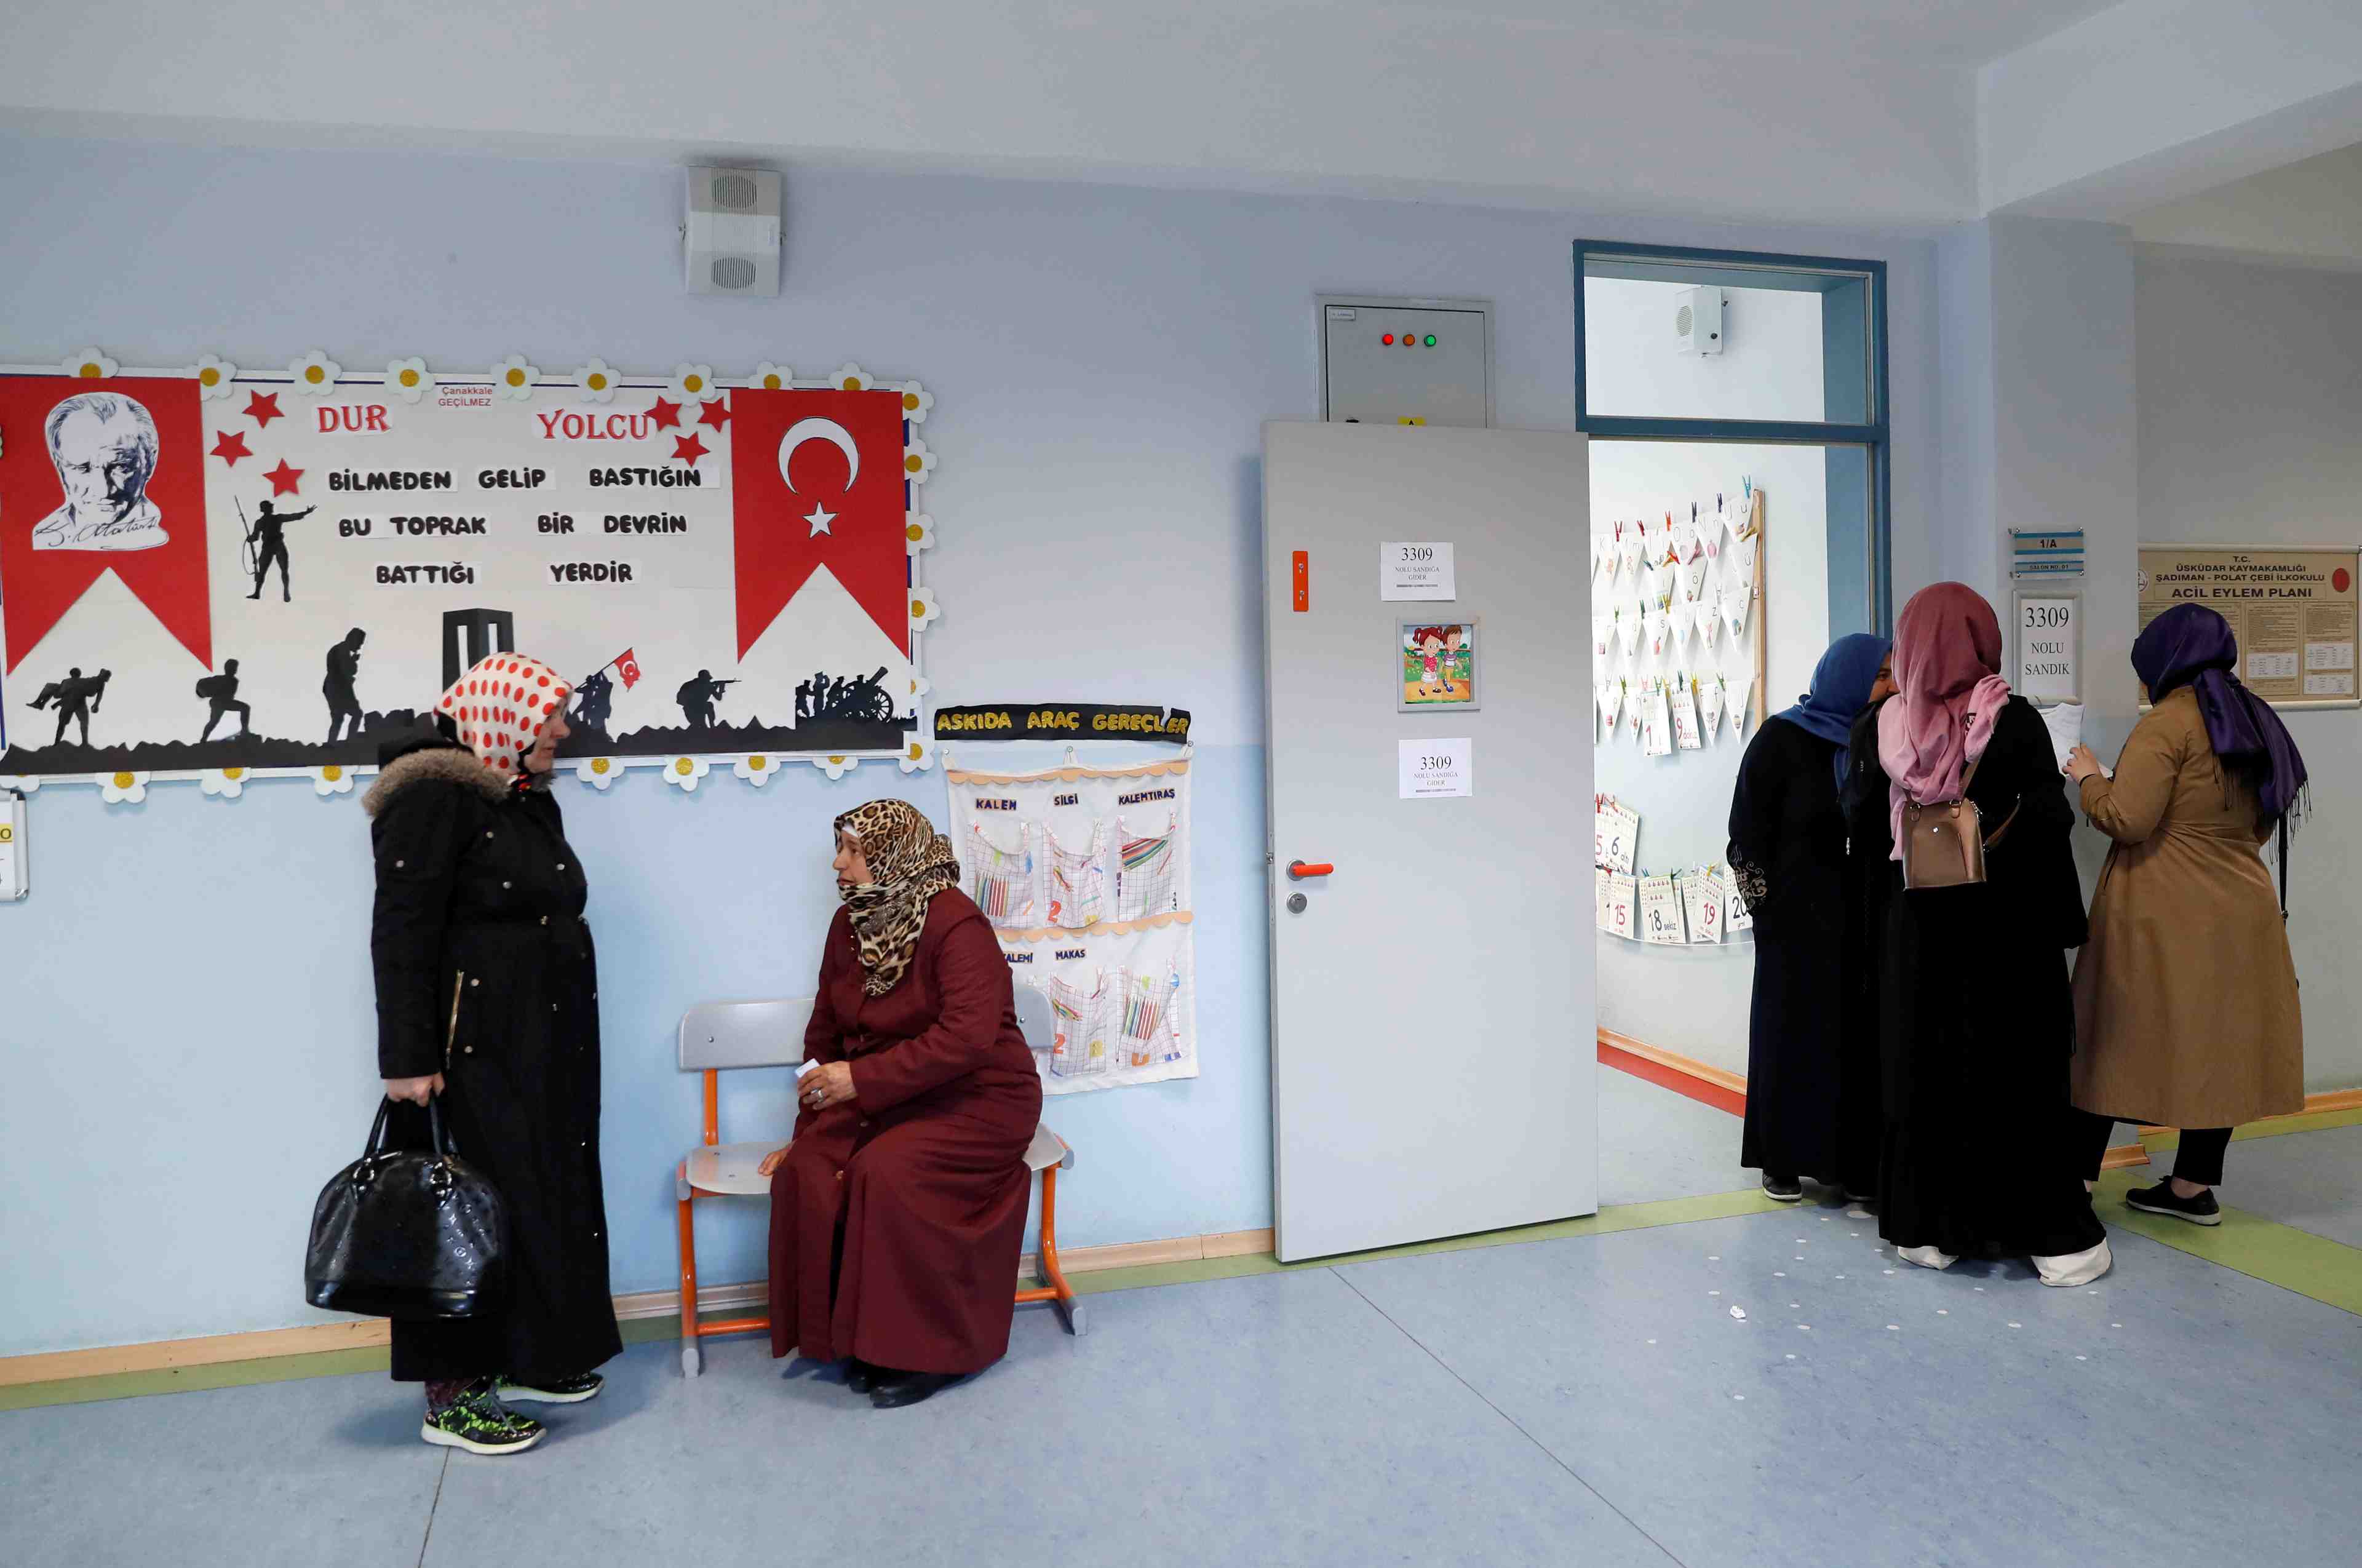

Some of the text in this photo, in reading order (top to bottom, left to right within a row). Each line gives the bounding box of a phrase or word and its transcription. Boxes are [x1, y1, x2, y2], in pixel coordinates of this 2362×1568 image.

[442, 386, 493, 397] Çanakkale
[438, 397, 491, 407] GEÇİLMEZ
[317, 404, 650, 440] DUR YOLCU
[328, 466, 701, 491] BİLMEDEN GELİP BASTIĞIN
[338, 512, 688, 537] BU TOPRAK BİR DEVRİN
[2039, 538, 2058, 549] 1/A
[1401, 547, 1433, 561] 3309
[376, 560, 632, 584] BATTIĞI YERDİR
[2176, 563, 2306, 572] ÜSKÜDAR KAYMAKAMLIĞI
[2171, 586, 2312, 598] ACİL EYLEM PLANI
[2025, 607, 2069, 628] 3309
[2030, 642, 2064, 654] NOLU
[2025, 664, 2070, 676] SANDIK
[936, 710, 1189, 734] ASKIDA ARAÇ GEREÇLER
[1420, 755, 1452, 770] 3309
[976, 788, 1175, 811] KALEM SİLGİ KALEMTIRAŞ
[1612, 836, 1620, 856] 6
[1615, 904, 1626, 926] 15
[1703, 902, 1716, 925] 19
[1732, 896, 1748, 919] 20
[1648, 909, 1663, 932] 18
[1055, 949, 1086, 960] MAKAS
